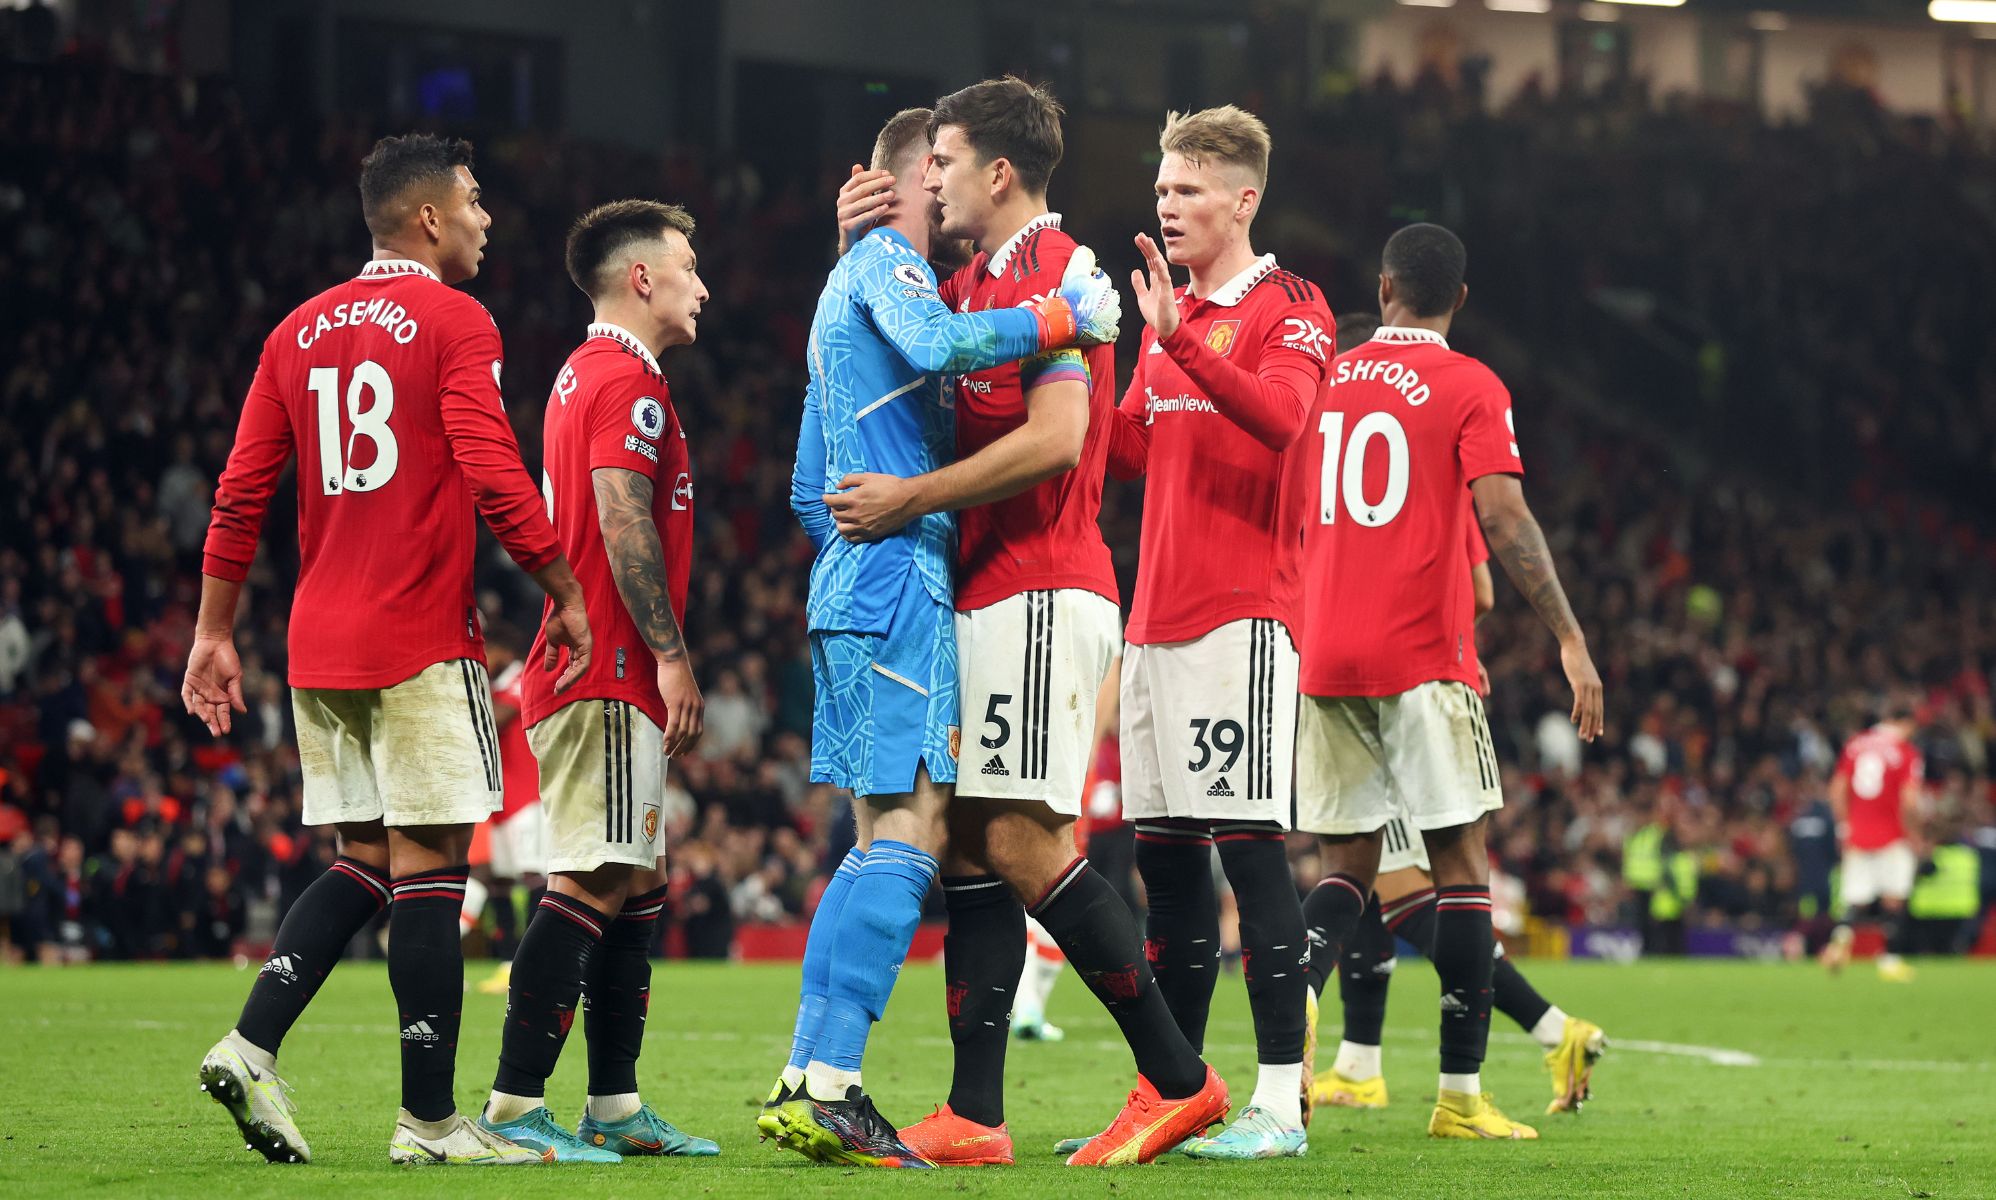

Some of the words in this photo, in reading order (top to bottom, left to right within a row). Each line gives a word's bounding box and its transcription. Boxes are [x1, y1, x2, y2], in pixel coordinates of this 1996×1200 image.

[297, 298, 418, 350] CASEMIRO
[1283, 318, 1333, 362] DXC
[307, 359, 399, 496] 18
[624, 443, 638, 451] for
[638, 446, 658, 464] racism
[626, 434, 640, 444] No
[639, 440, 657, 455] room
[1317, 411, 1411, 528] 10
[980, 694, 1013, 750] 5
[1187, 718, 1245, 773] 39
[981, 767, 1010, 777] adidas
[1206, 789, 1236, 797] adidas
[399, 1031, 440, 1042] adidas
[951, 1135, 991, 1147] ULTRA
